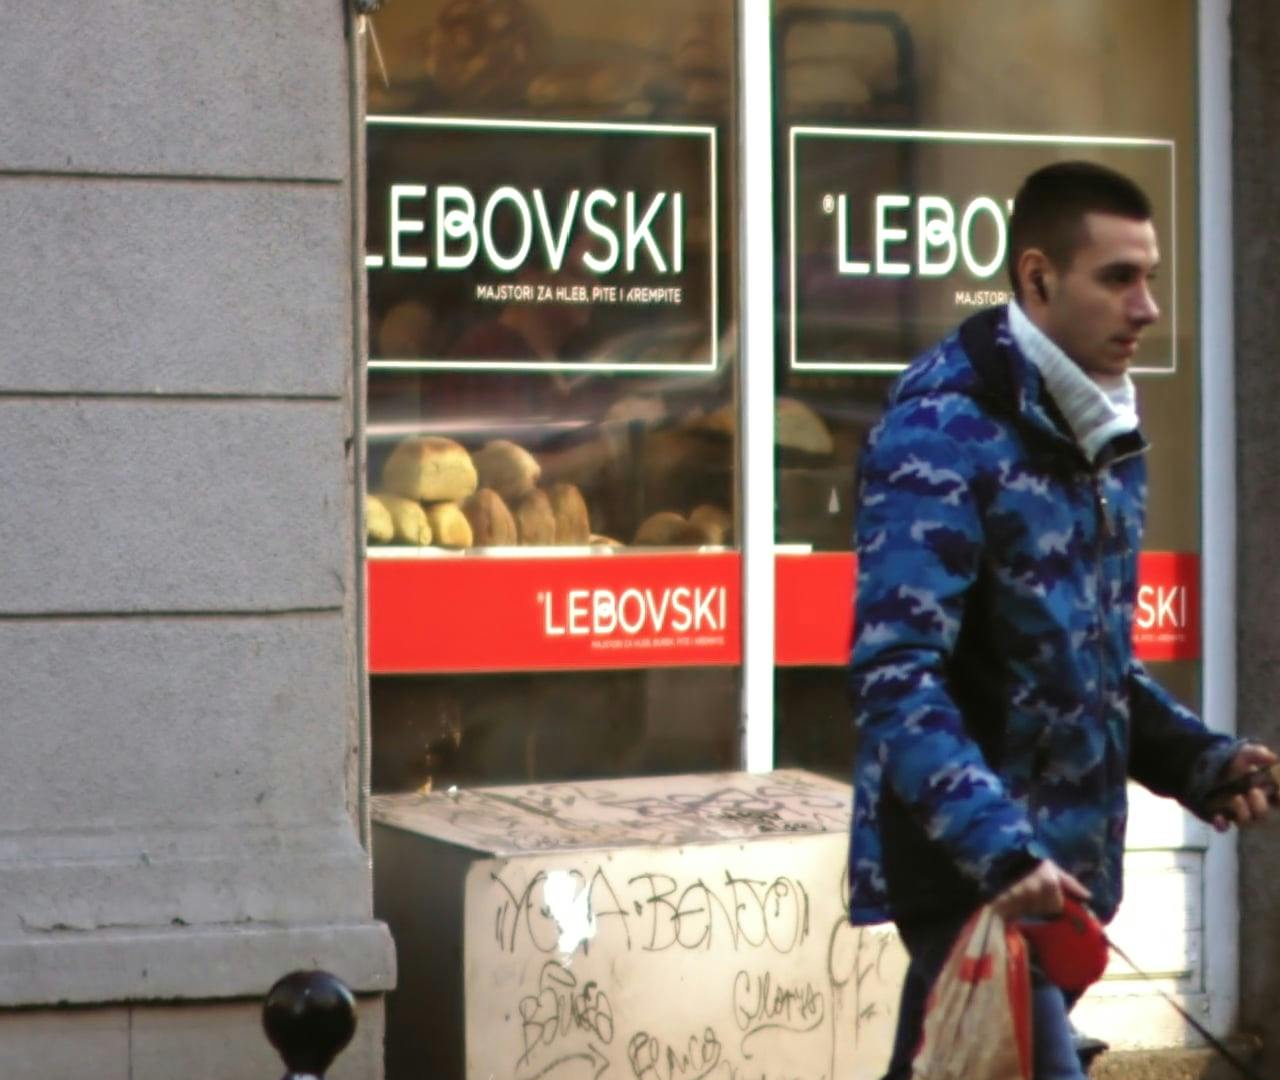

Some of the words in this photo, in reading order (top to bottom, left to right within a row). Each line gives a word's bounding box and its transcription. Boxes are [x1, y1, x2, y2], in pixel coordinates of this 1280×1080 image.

[476, 284, 534, 301] MAJSTORI
[537, 285, 554, 301] ZA
[556, 285, 590, 303] HLEB,
[592, 286, 617, 303] PITE
[627, 287, 683, 304] KREMPITE
[544, 586, 727, 635] LEBOVSKI
